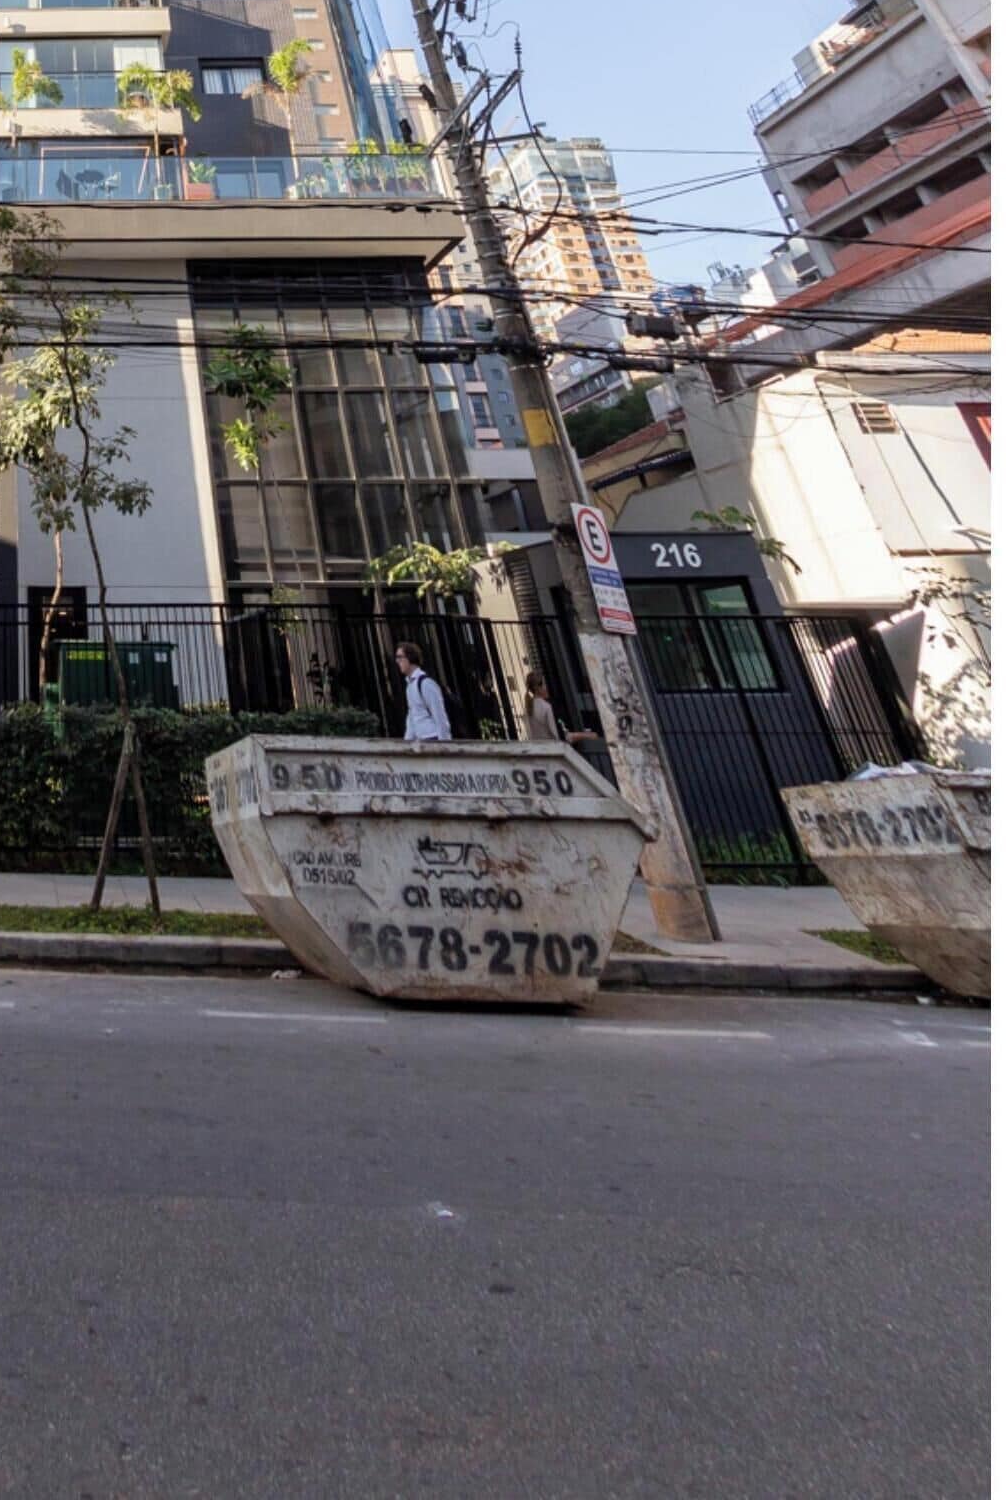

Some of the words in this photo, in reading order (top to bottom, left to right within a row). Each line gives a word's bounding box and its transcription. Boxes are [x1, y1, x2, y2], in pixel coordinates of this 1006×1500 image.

[586, 520, 602, 551] E
[650, 542, 702, 569] 216
[272, 763, 344, 790] 950
[511, 769, 573, 796] 950
[347, 921, 601, 977] 5678-2702
